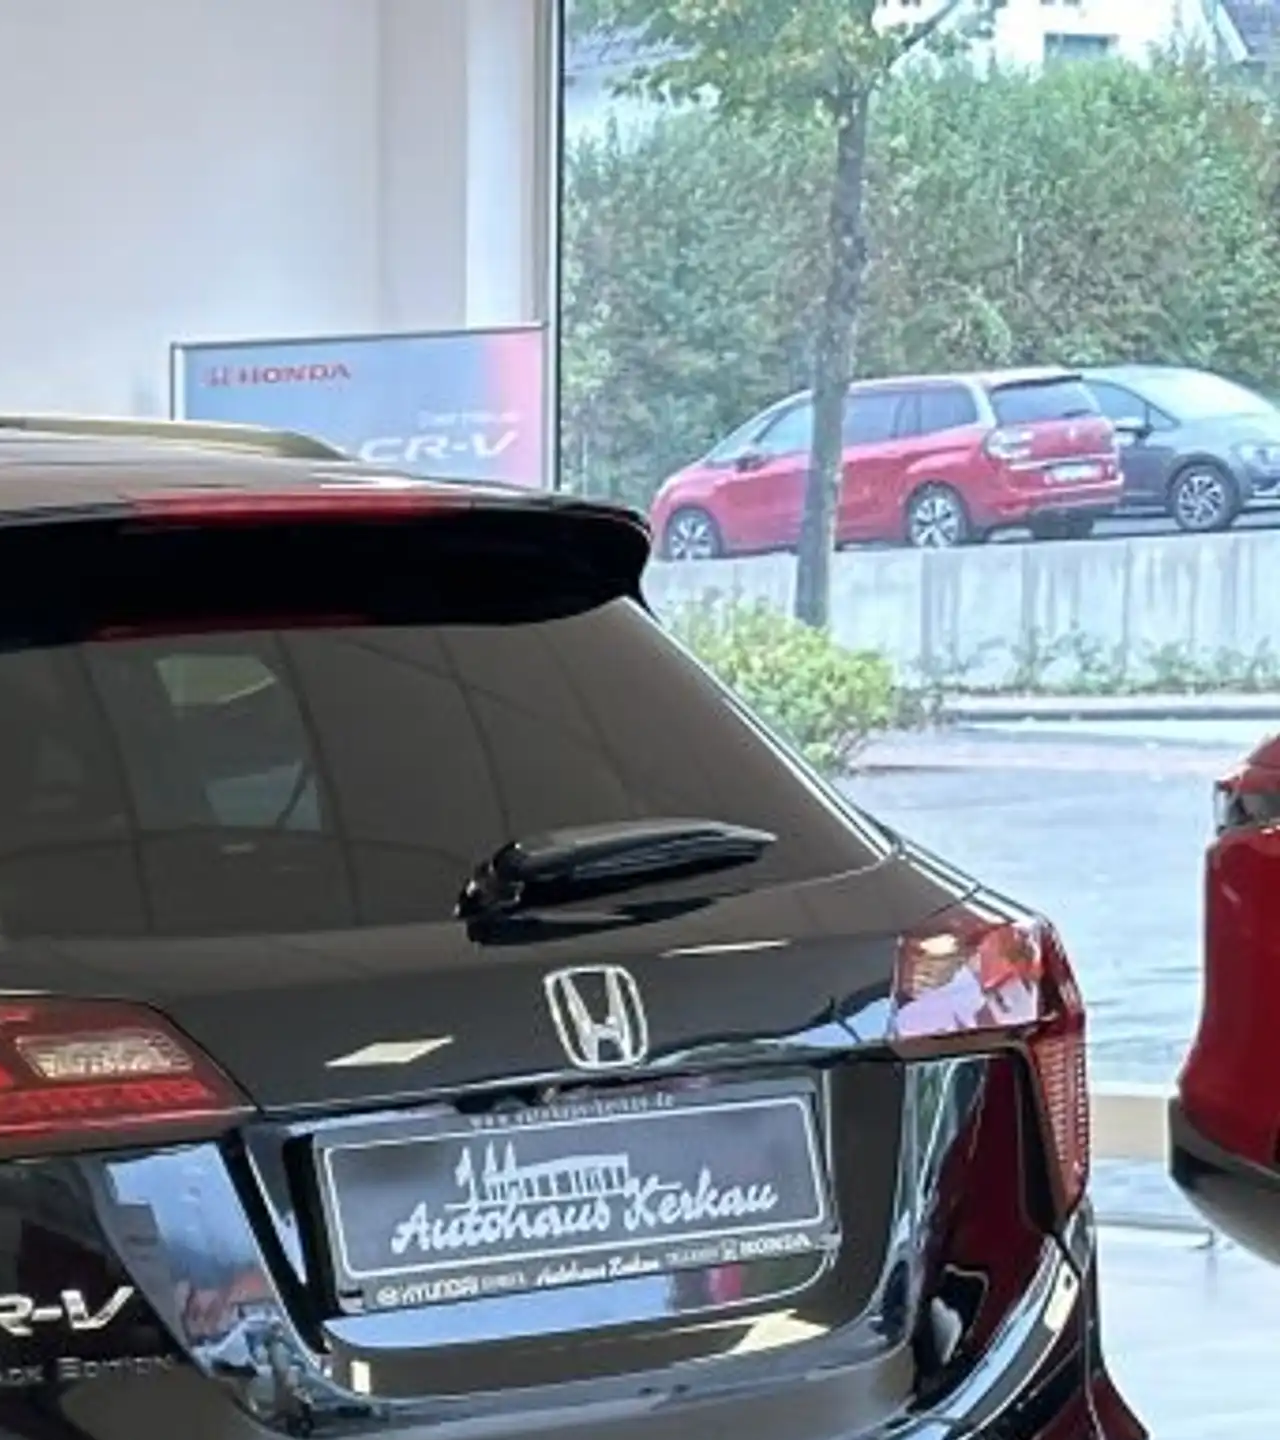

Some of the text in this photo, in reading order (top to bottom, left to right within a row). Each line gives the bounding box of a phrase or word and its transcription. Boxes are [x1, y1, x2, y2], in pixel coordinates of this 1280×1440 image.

[241, 363, 352, 387] HONDA
[359, 431, 520, 465] CR-V
[390, 1166, 780, 1254] Autohaus Kerkau
